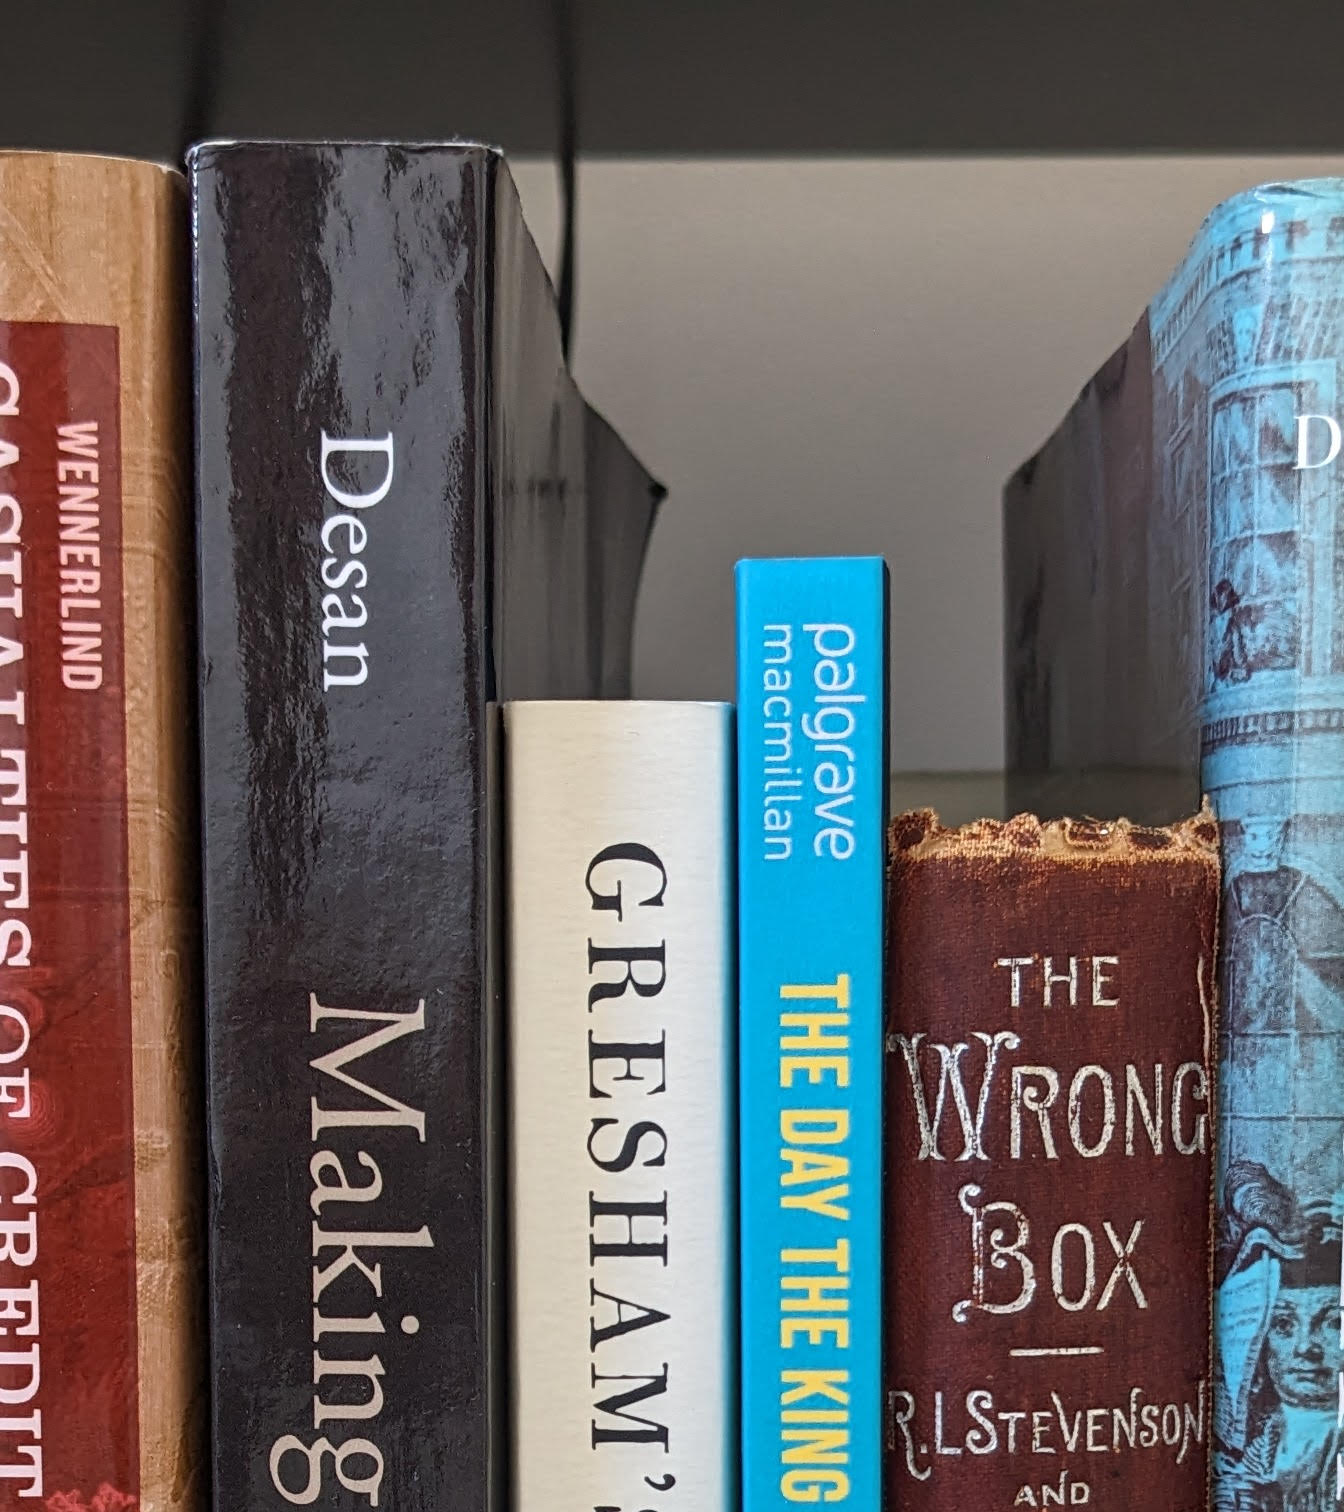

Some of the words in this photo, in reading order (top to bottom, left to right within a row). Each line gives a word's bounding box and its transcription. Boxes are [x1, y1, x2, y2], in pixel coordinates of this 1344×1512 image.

[56, 421, 102, 692] WENNERLIND
[319, 428, 394, 693] Desan
[761, 622, 802, 862] macmillan
[801, 623, 866, 862] palgrave
[779, 973, 851, 1088] THE
[997, 955, 1120, 1008] THE
[887, 1032, 1210, 1161] WRONG
[779, 1109, 850, 1222] DAY
[268, 993, 436, 1508] Making
[779, 1238, 850, 1351] THE
[951, 1184, 1149, 1323] BOX
[780, 1369, 850, 1504] KING
[1013, 1469, 1090, 1507] AND
